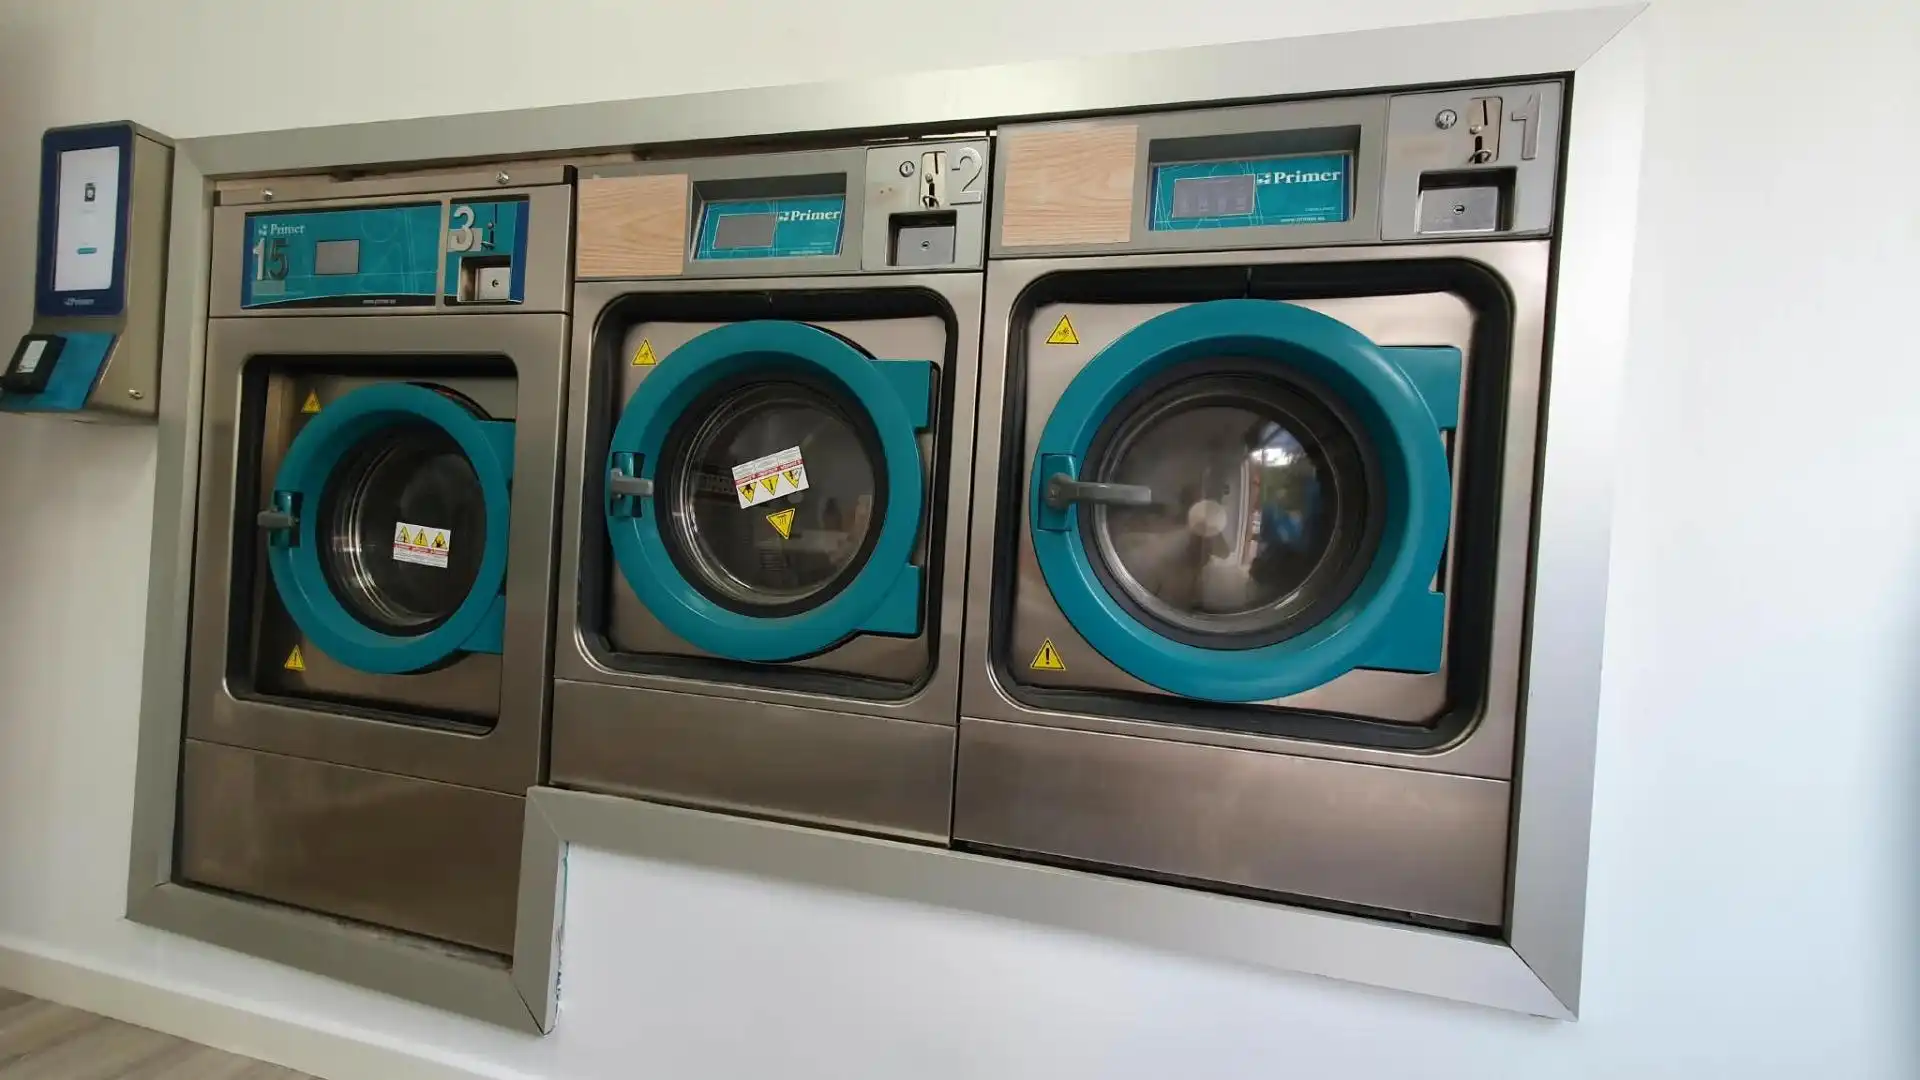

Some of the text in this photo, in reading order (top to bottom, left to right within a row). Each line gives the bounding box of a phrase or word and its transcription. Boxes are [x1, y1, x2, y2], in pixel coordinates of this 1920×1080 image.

[1512, 93, 1542, 160] 1
[949, 147, 983, 206] 2
[1275, 170, 1341, 185] Primer
[270, 223, 305, 236] Primer
[453, 206, 475, 252] 3
[790, 209, 841, 222] Primer
[253, 238, 288, 280] 15
